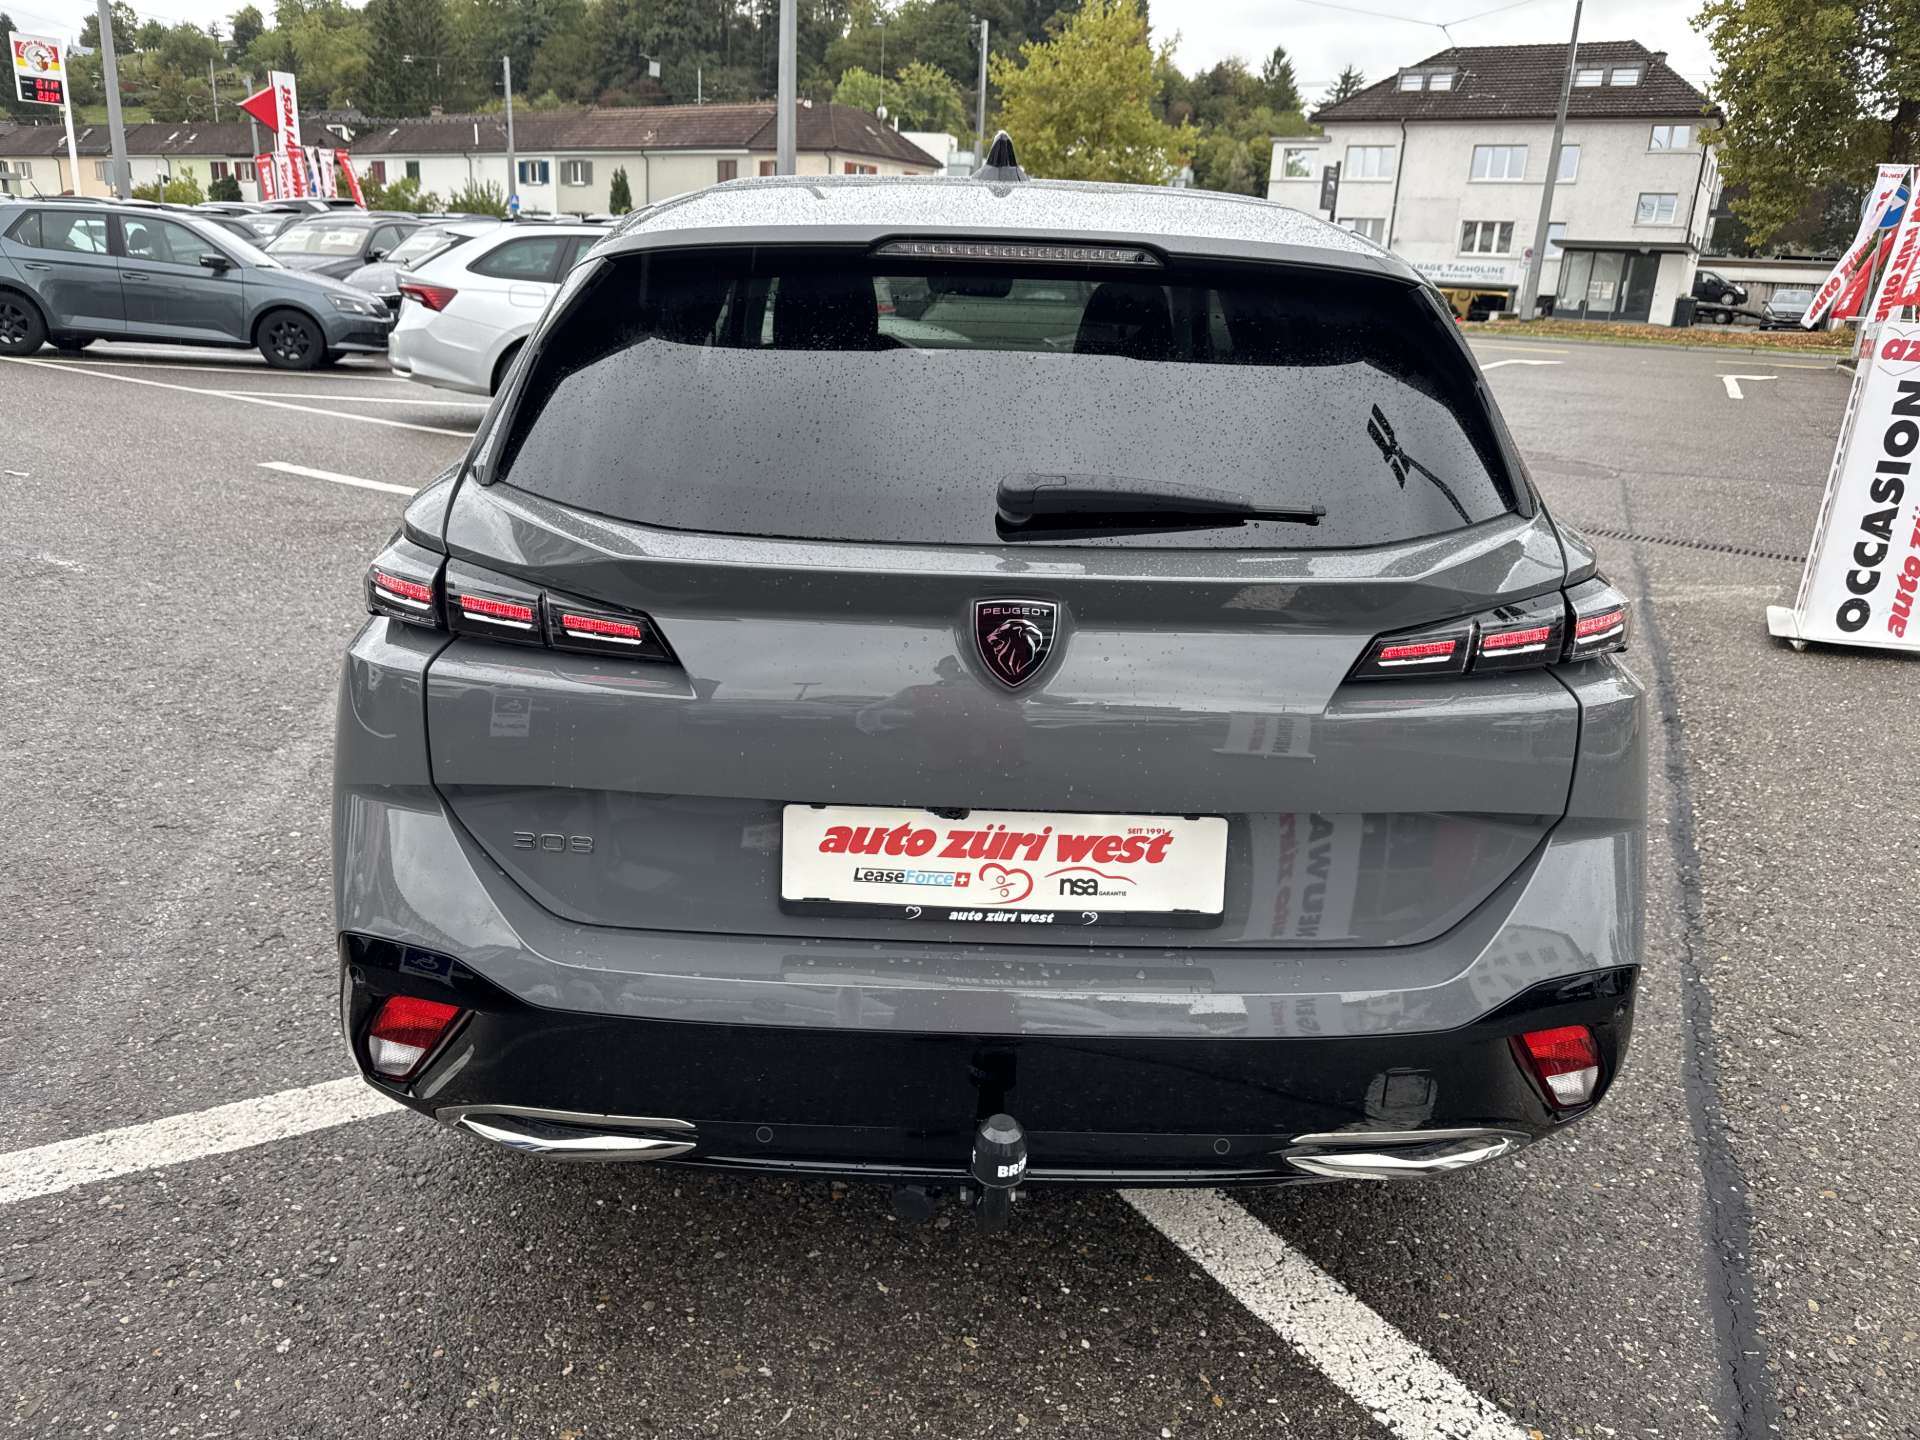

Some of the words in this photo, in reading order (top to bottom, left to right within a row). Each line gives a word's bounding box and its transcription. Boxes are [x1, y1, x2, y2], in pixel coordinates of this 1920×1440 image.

[1447, 264, 1505, 274] TACHOLINE
[1809, 276, 1841, 320] auto
[983, 607, 1050, 617] PEUGEOT
[1146, 828, 1166, 836] 1991
[512, 831, 594, 853] 308
[819, 821, 937, 857] auto
[938, 824, 1053, 862] züri
[1056, 830, 1175, 864] west
[853, 867, 955, 886] LeaseForce
[1059, 878, 1099, 896] nsa
[948, 910, 983, 921] auto
[985, 911, 1018, 922] züri
[1020, 912, 1055, 923] west
